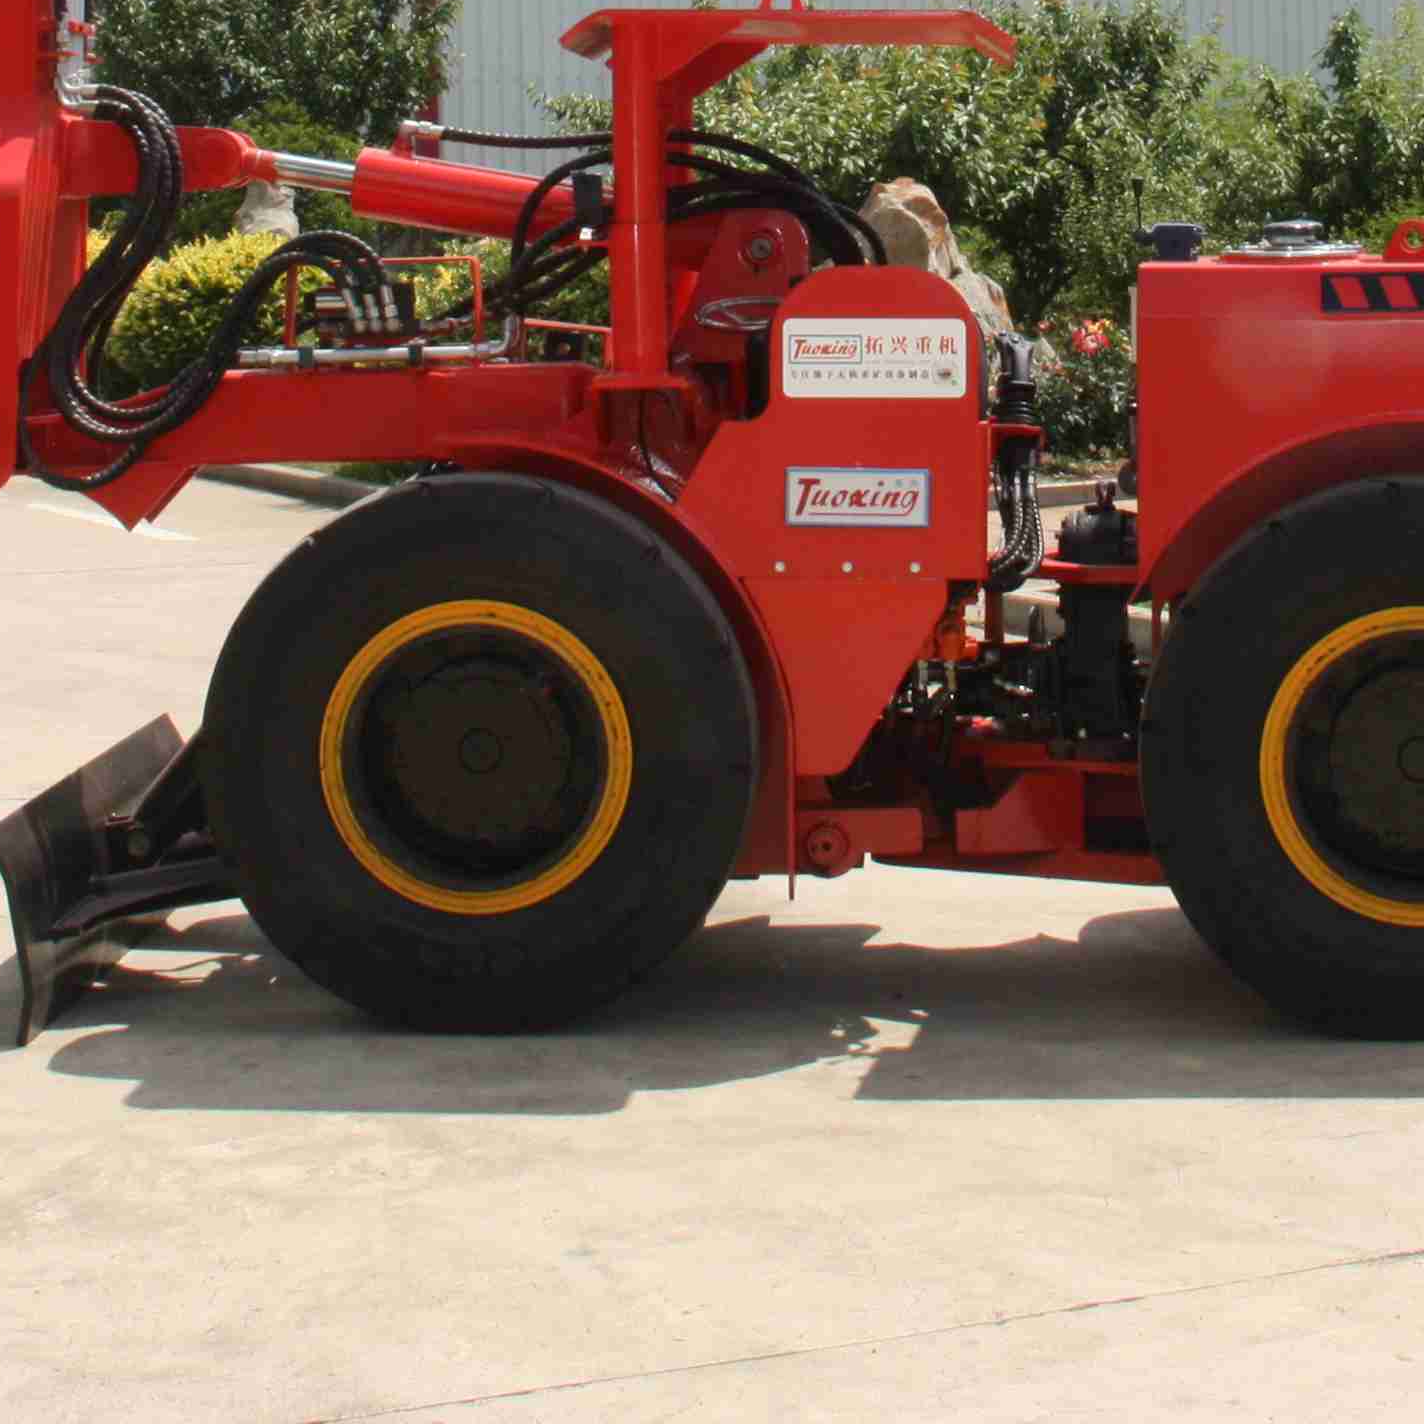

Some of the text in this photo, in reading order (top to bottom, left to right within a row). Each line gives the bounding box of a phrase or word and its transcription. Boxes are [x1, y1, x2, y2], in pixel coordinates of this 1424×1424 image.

[793, 338, 858, 360] Tuoxing
[864, 335, 958, 355] 拓兴重机
[795, 478, 919, 516] Tuoxing
